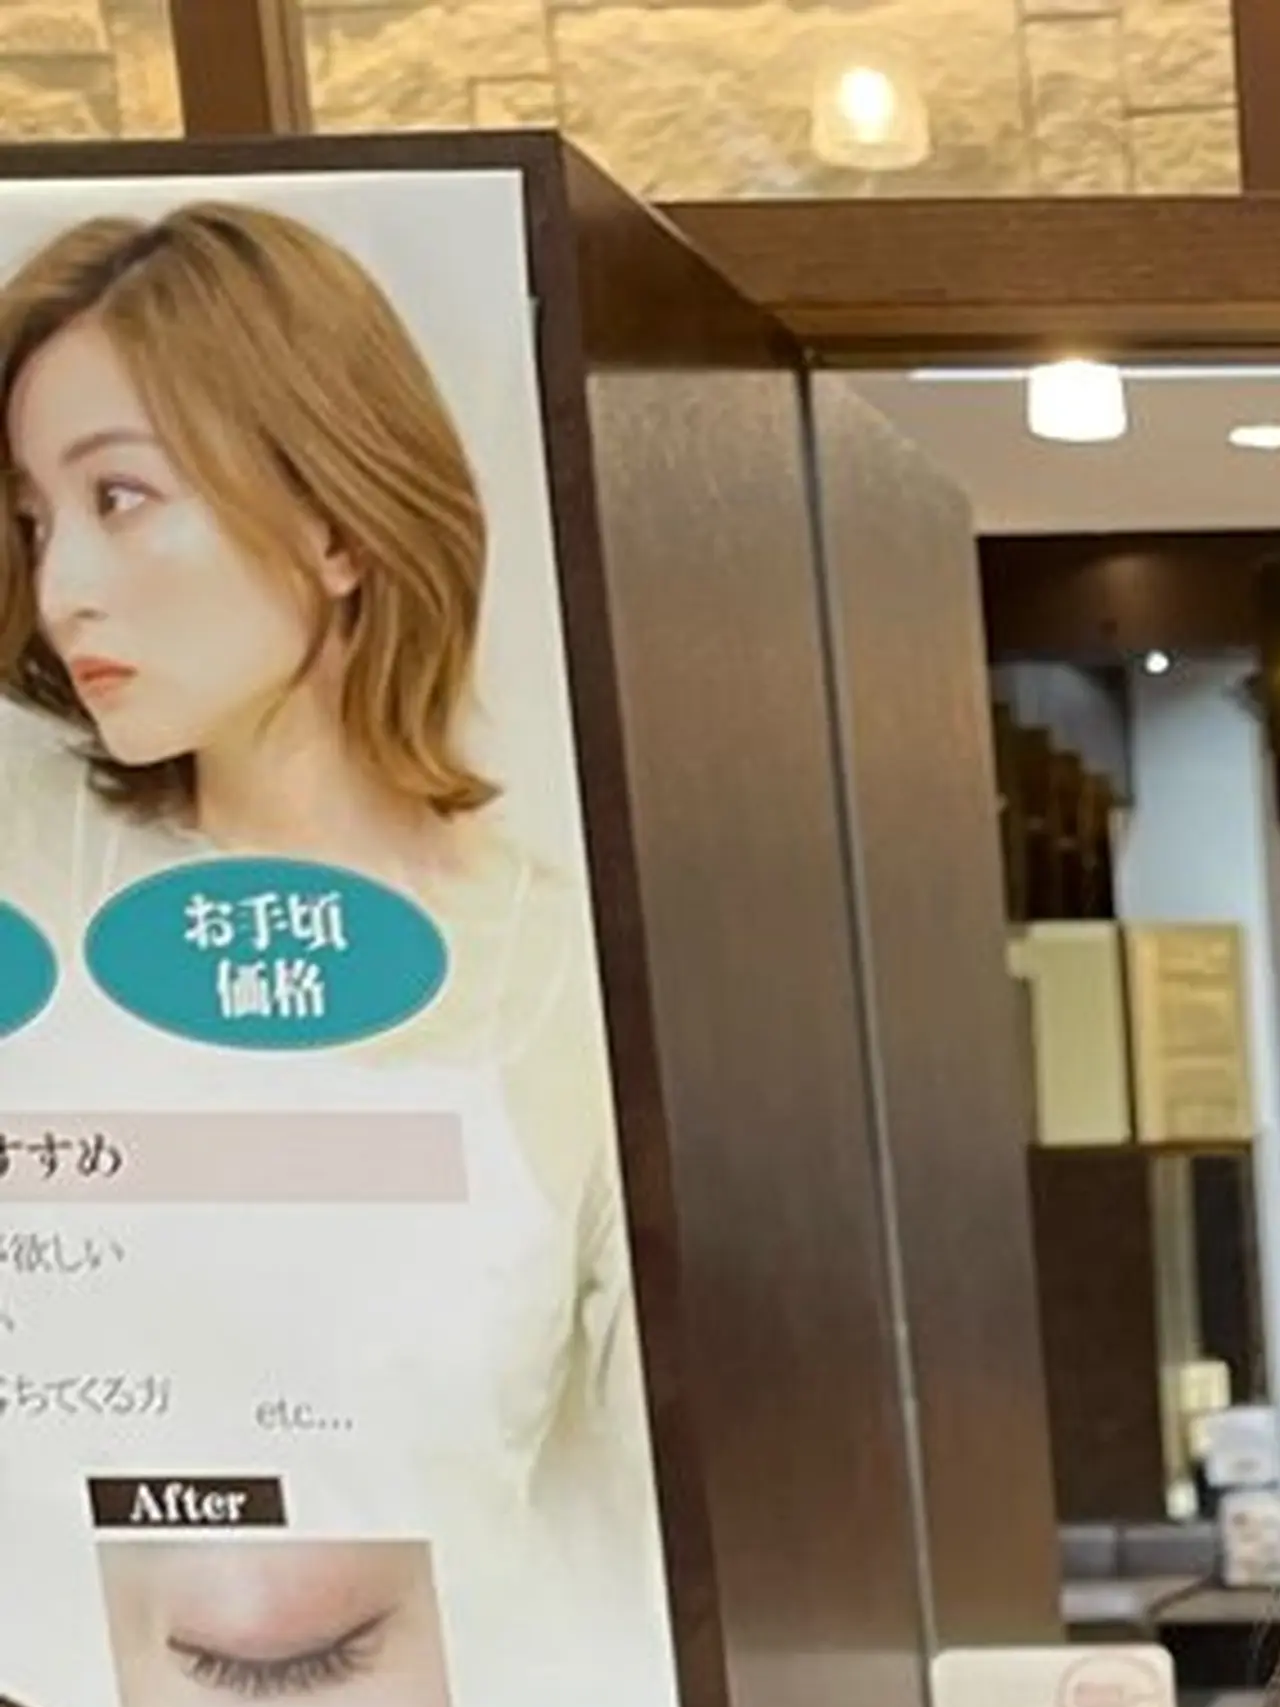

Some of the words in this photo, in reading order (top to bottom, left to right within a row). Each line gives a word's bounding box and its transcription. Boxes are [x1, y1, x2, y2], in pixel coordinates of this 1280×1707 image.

[184, 889, 349, 953] お手頃
[216, 961, 327, 1019] 価格
[0, 1233, 126, 1274] 欲しい
[0, 1375, 171, 1416] ちてくる方
[129, 1483, 247, 1523] After
